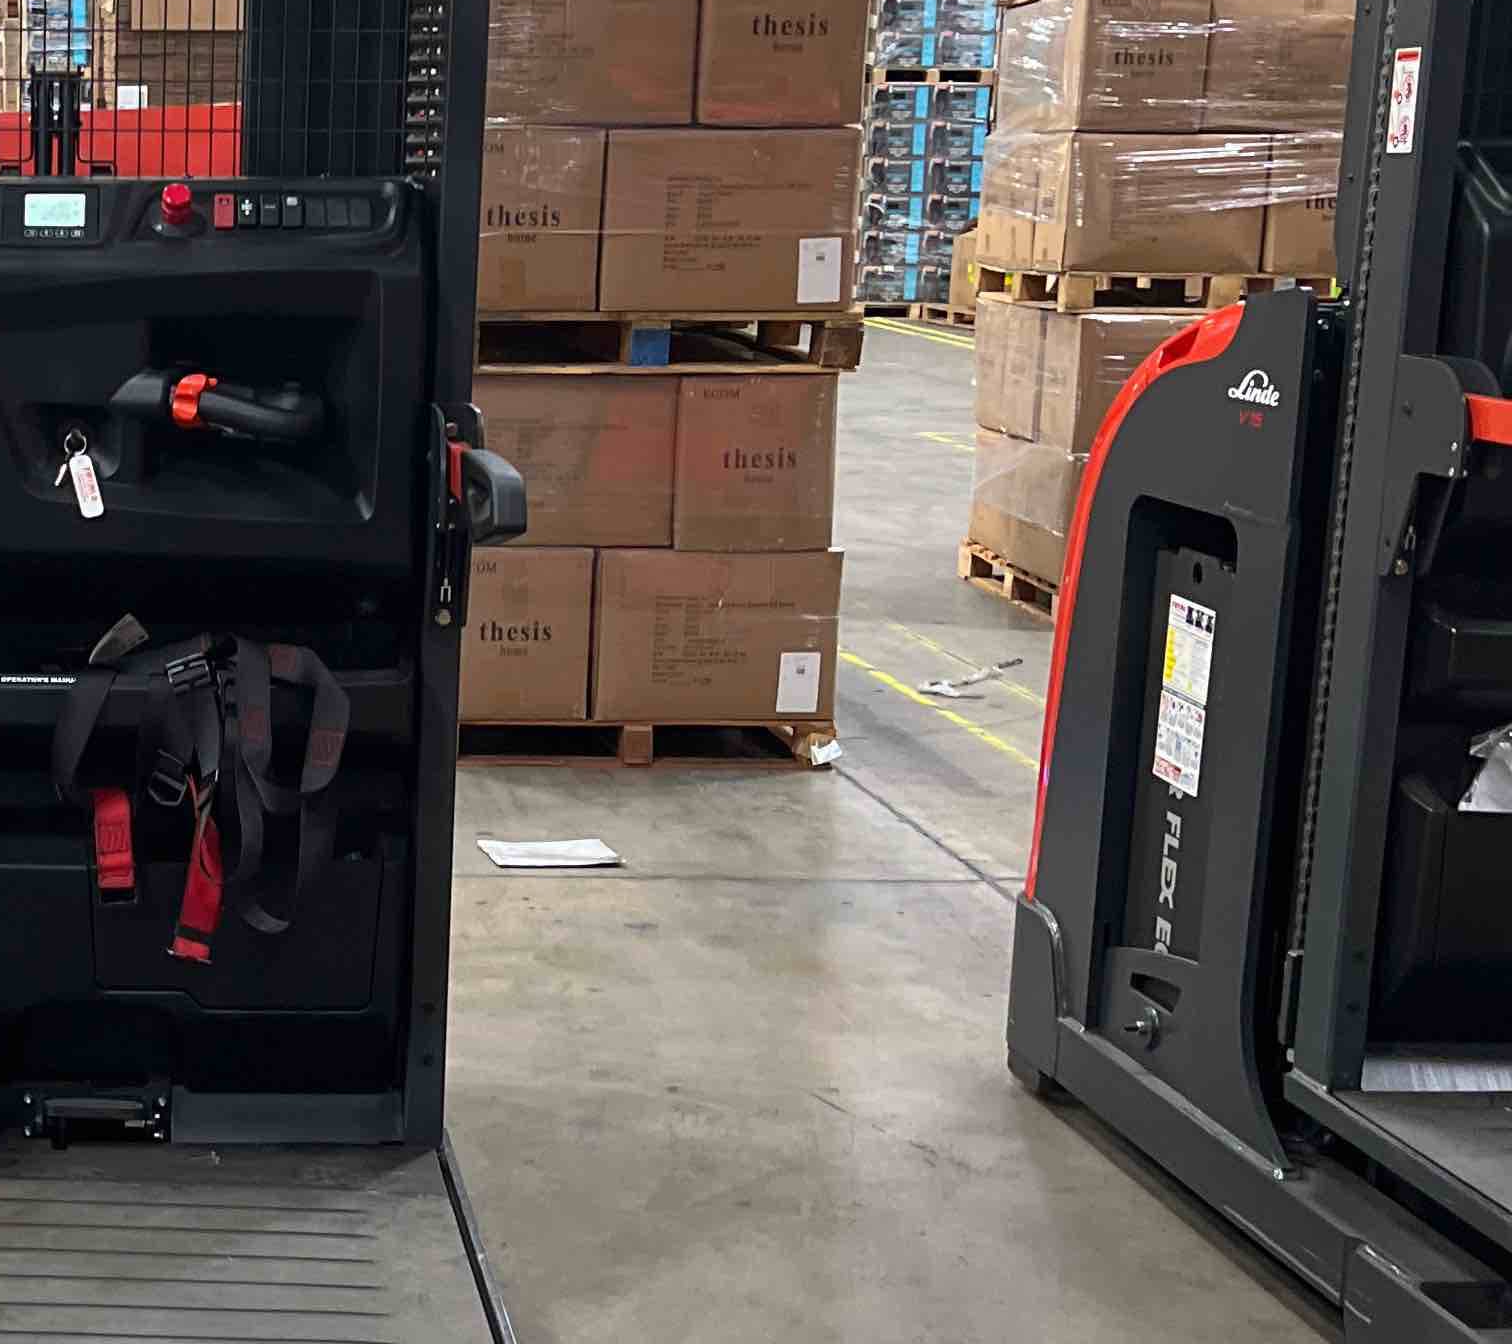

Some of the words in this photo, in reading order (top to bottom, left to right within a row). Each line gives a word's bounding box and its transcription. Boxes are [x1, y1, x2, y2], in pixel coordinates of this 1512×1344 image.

[752, 13, 829, 36] thesis
[1114, 47, 1175, 66] thesis
[486, 203, 561, 227] thesis
[1227, 369, 1281, 407] Linde
[722, 446, 797, 469] thesis
[479, 620, 553, 641] thesis
[1158, 810, 1182, 910] FLEX
